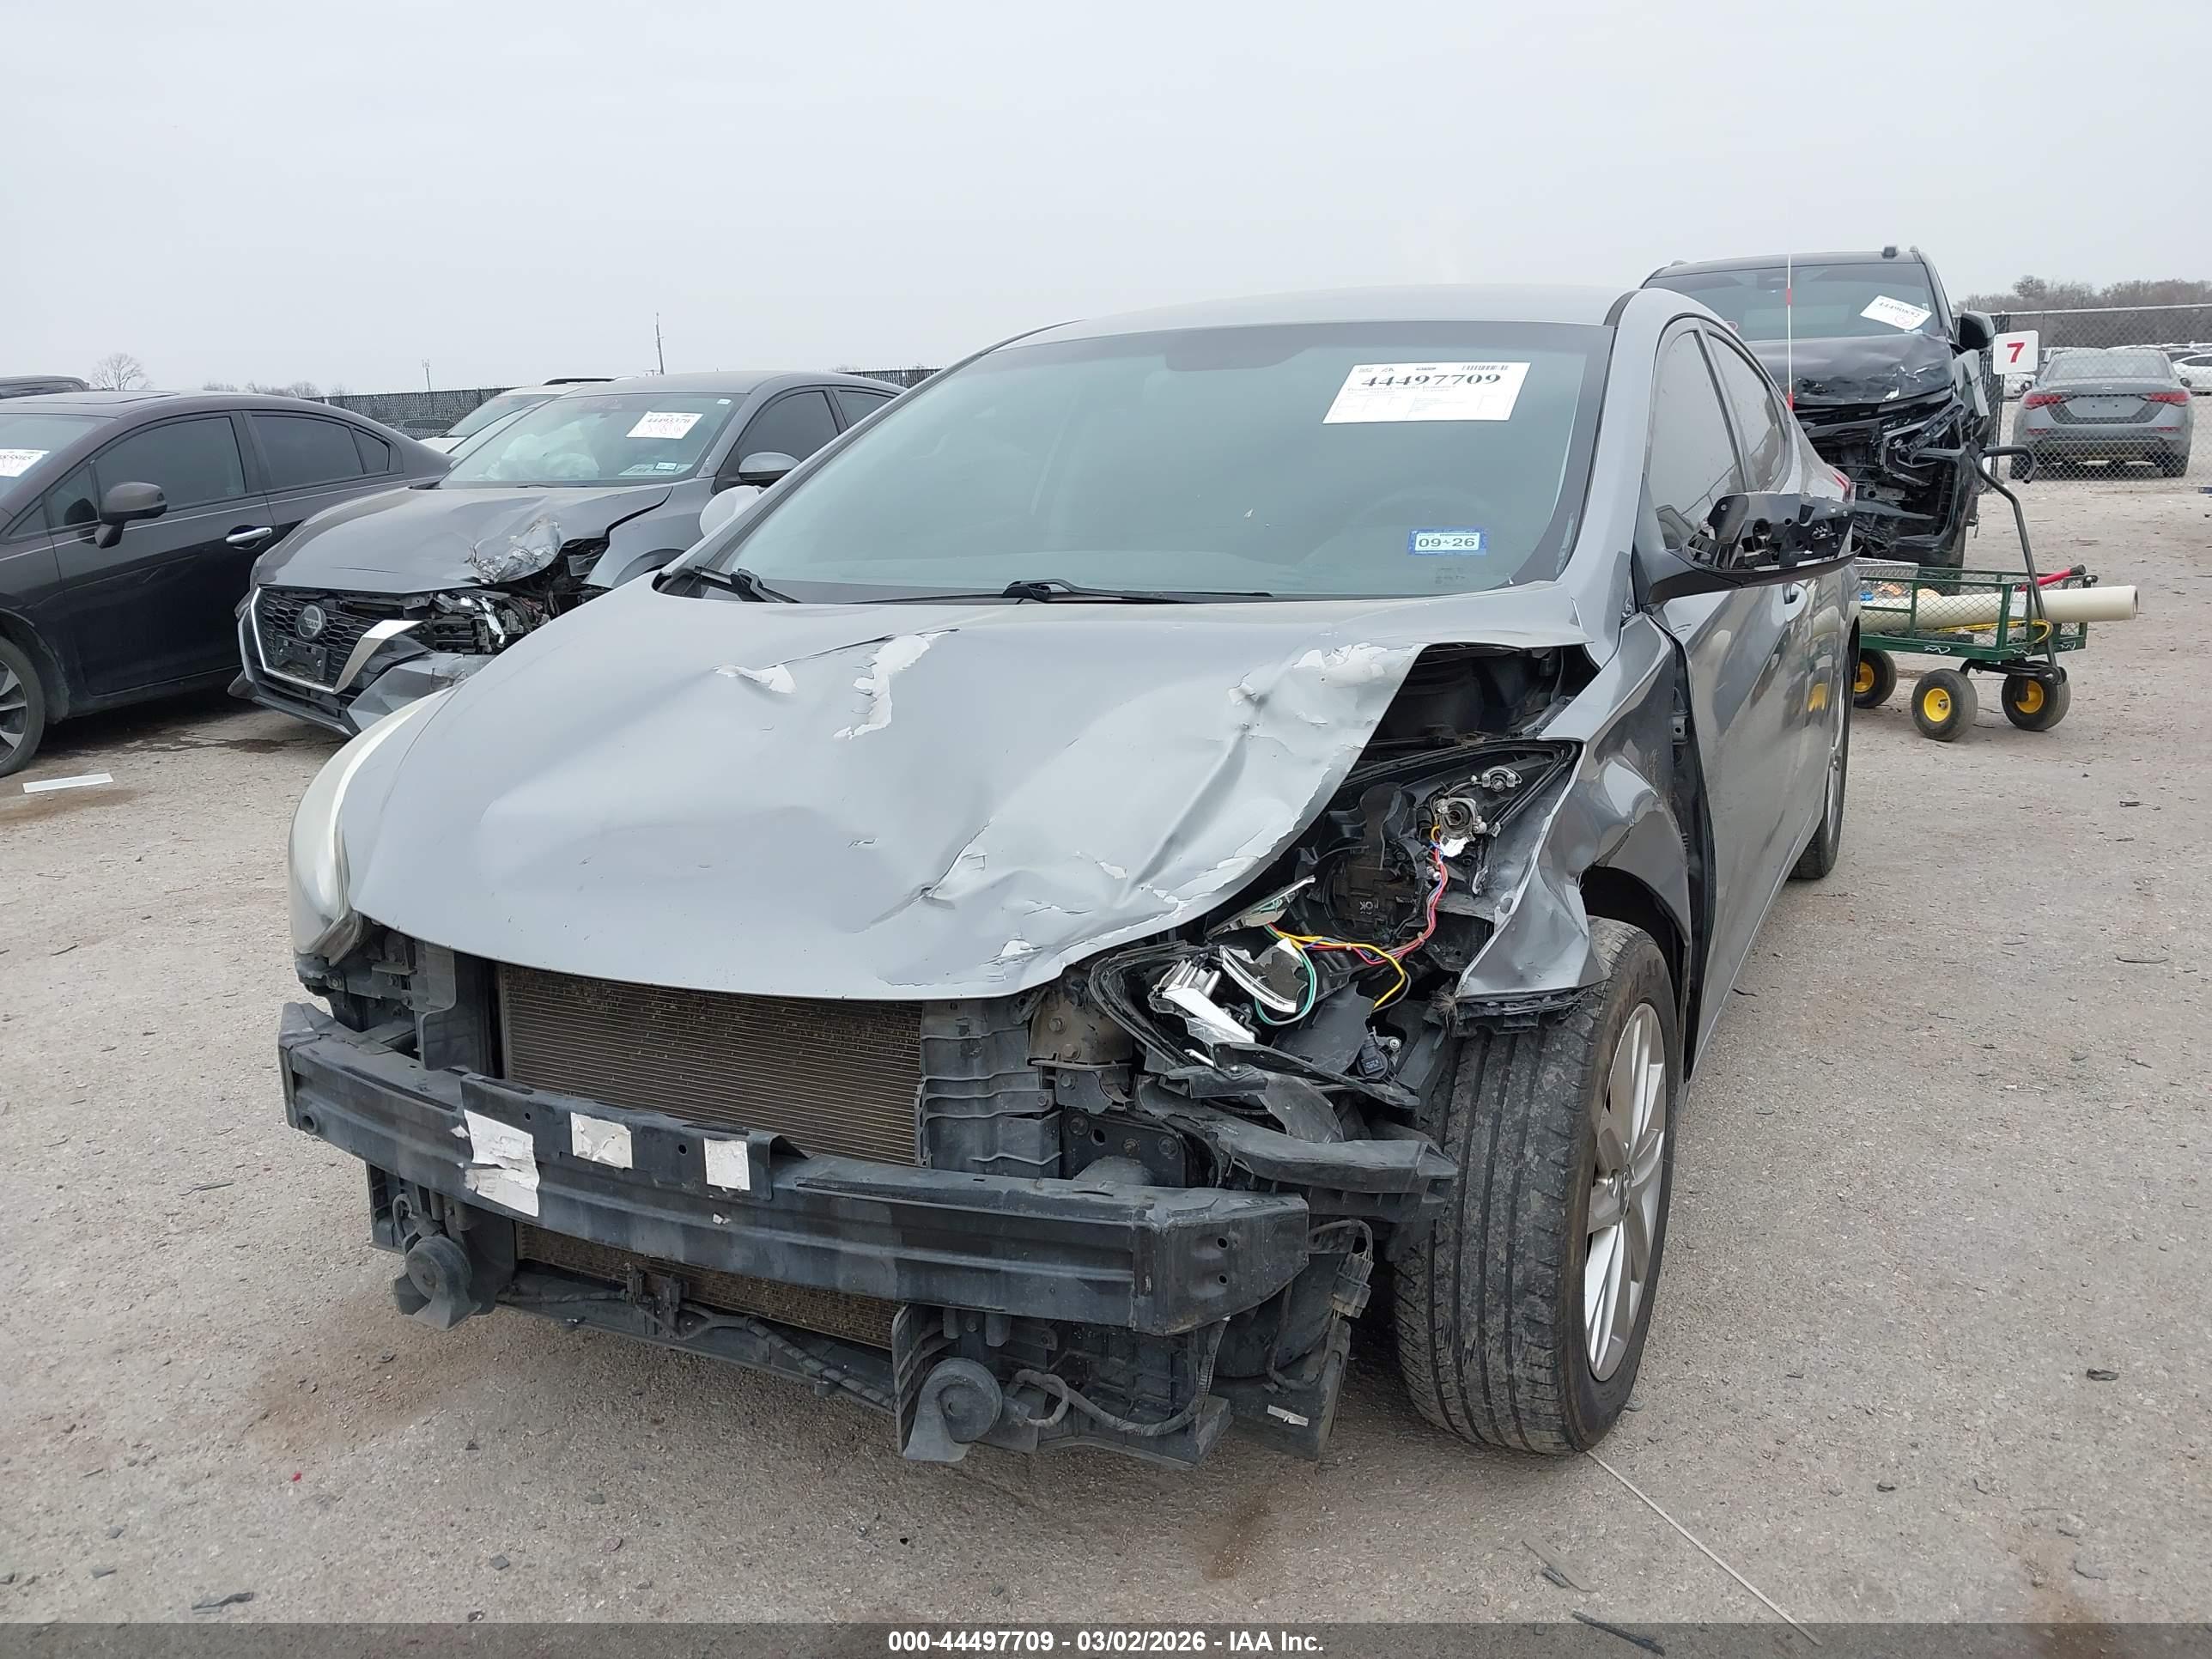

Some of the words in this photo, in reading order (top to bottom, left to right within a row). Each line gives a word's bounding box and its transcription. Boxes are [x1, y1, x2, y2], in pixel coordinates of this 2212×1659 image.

[2007, 342, 2025, 363] 7
[1362, 374, 1501, 386] 44497709
[1419, 538, 1442, 548] 09
[1451, 538, 1475, 548] 26
